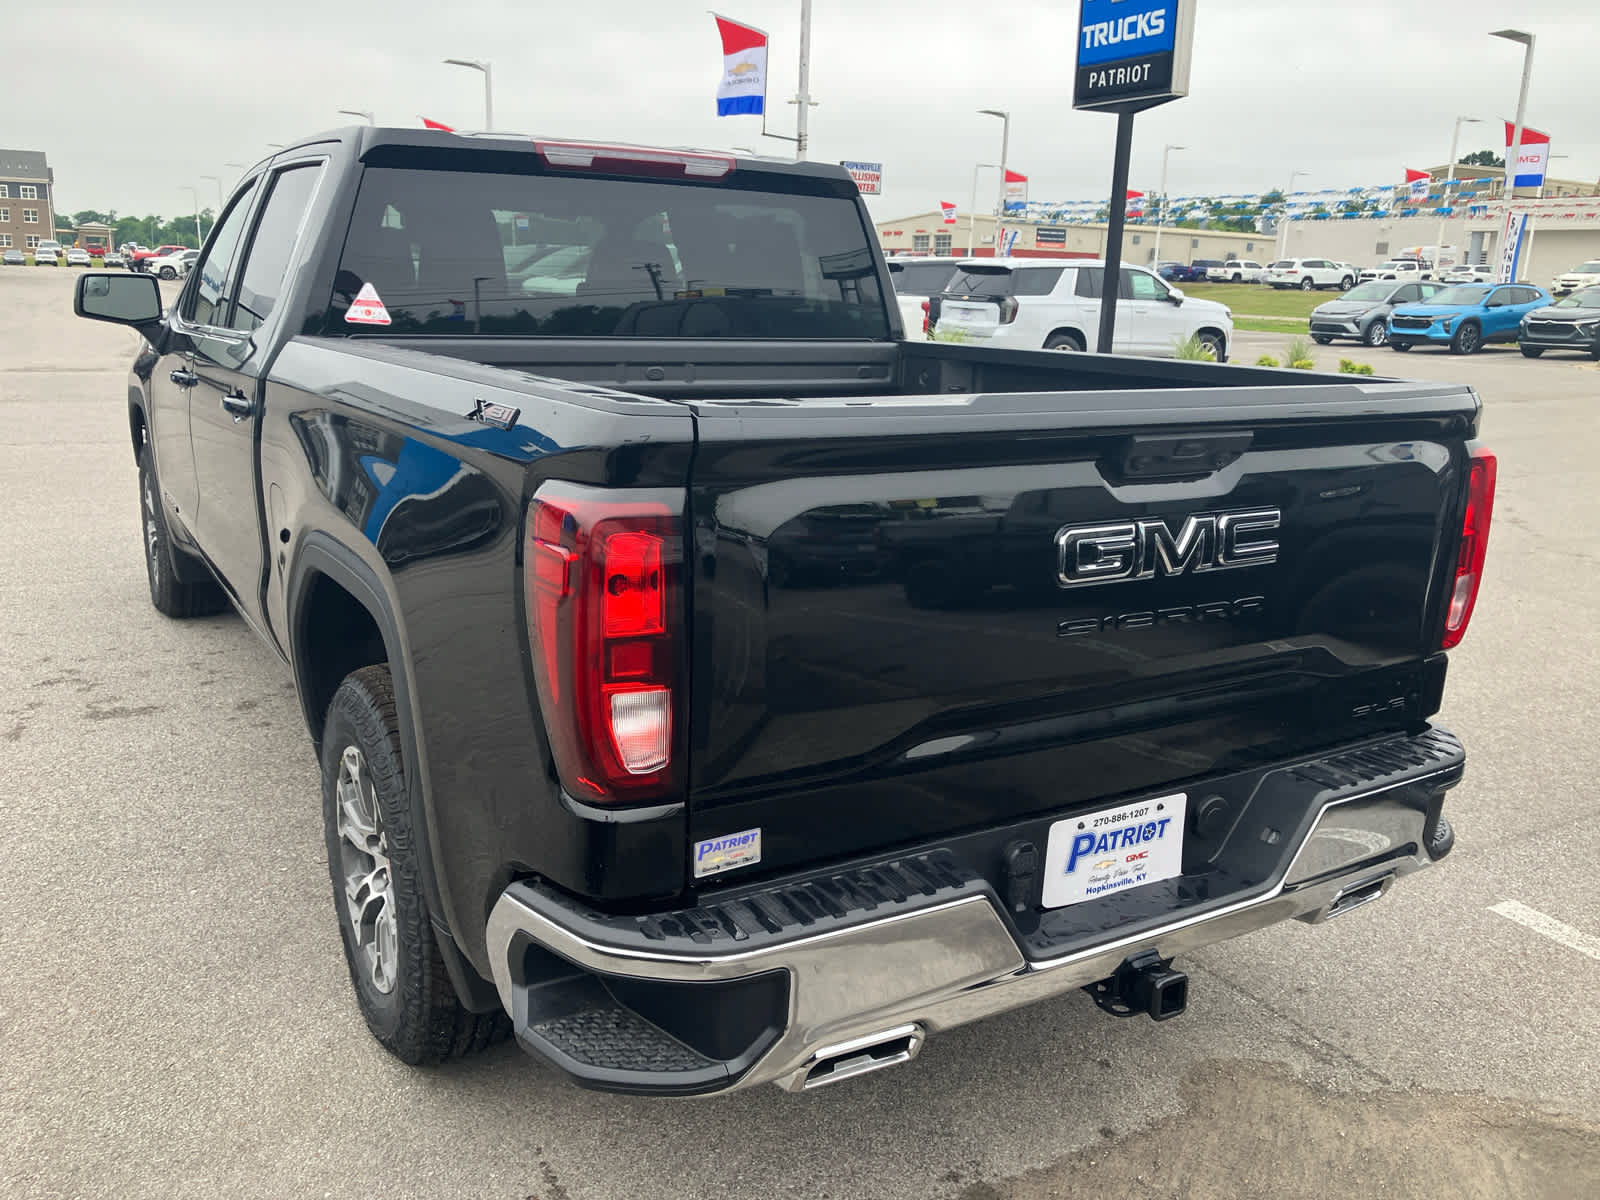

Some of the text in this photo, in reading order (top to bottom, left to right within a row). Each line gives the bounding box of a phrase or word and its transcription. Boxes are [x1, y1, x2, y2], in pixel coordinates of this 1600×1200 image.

[1082, 8, 1166, 49] TRUCKS
[1089, 63, 1151, 89] PATRIOT
[850, 170, 881, 182] OLLISION
[1054, 504, 1281, 589] GMC
[1057, 595, 1265, 637] SIERRA
[1093, 807, 1150, 828] 270-886-1207
[697, 832, 758, 862] PATRIOT
[1064, 817, 1172, 875] PATRIOT
[1125, 850, 1149, 863] GMC
[1086, 877, 1136, 895] Hopkinsville,
[1136, 872, 1148, 882] KY
